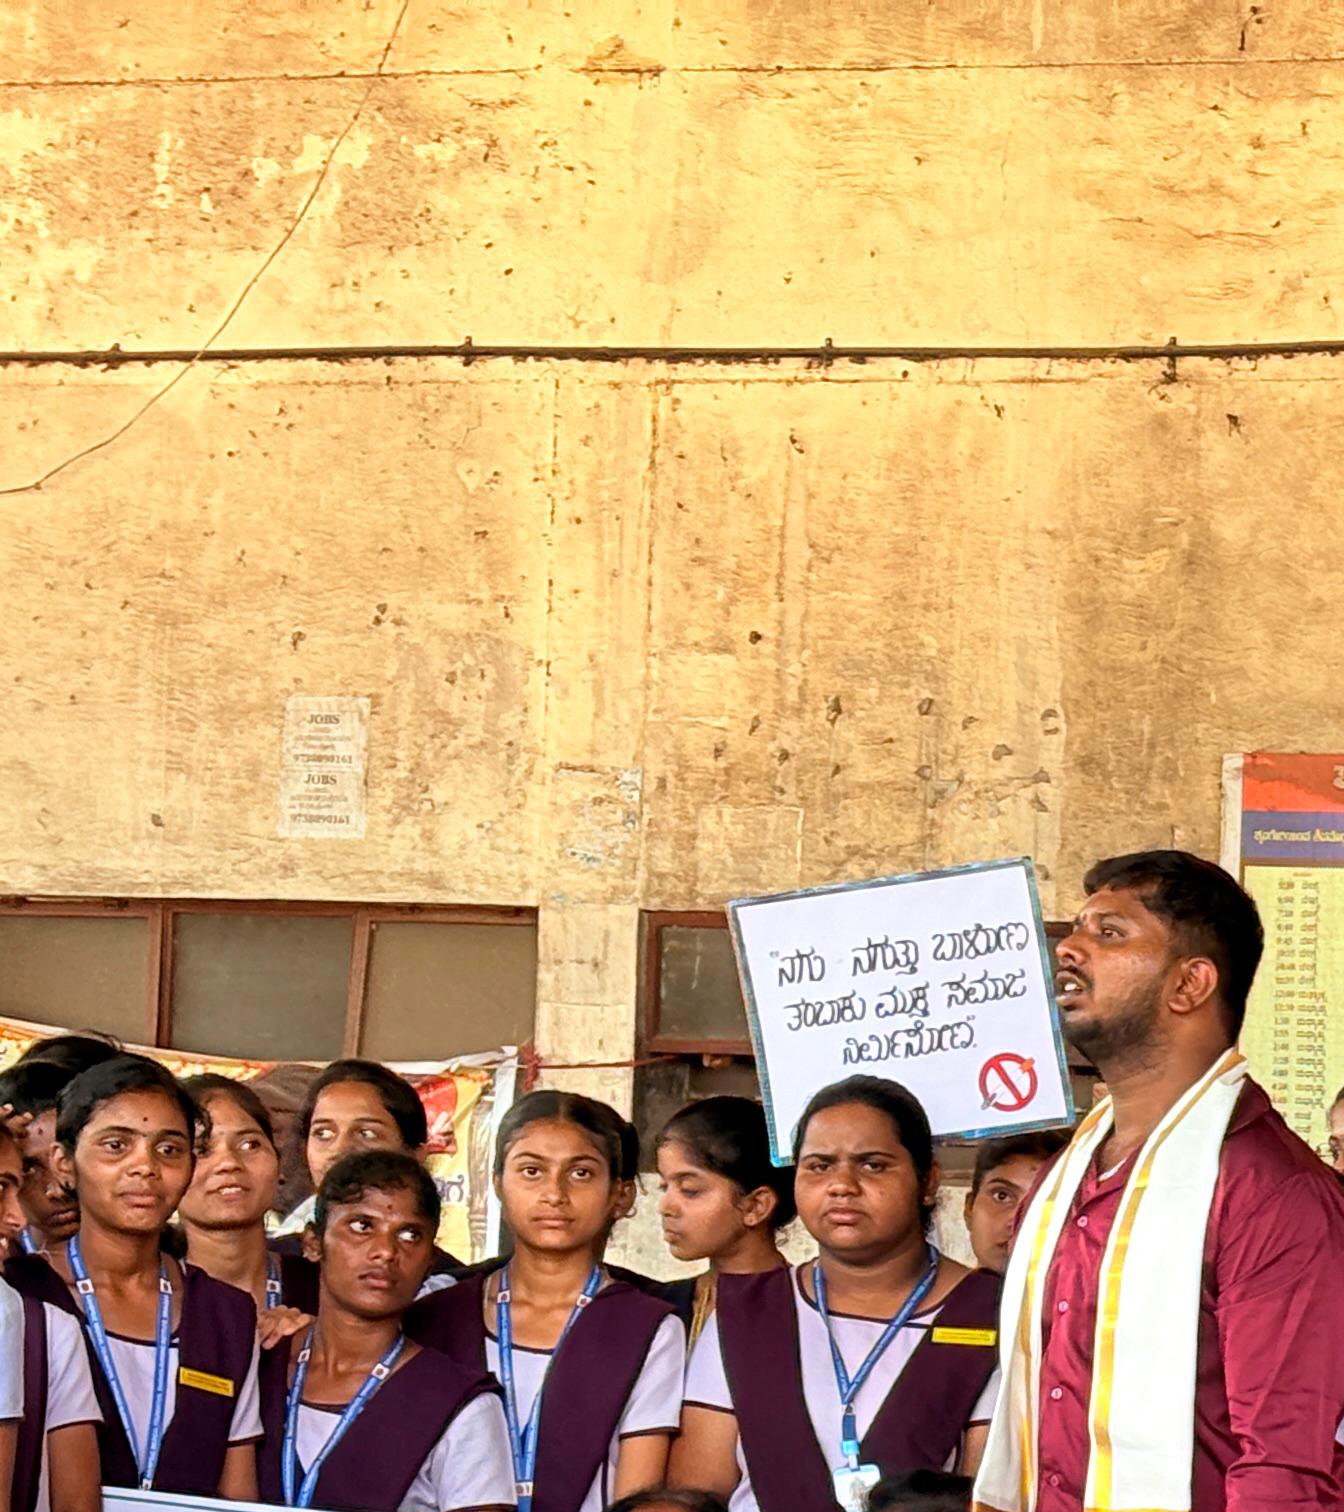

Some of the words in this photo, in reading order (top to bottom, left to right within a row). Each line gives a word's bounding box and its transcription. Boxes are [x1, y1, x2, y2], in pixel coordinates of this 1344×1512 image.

[308, 714, 341, 725] JOBS
[304, 773, 338, 786] JOBS
[783, 990, 867, 1031] ತಂಬಾಕು
[940, 968, 1028, 1009] ಸಮಾಜ
